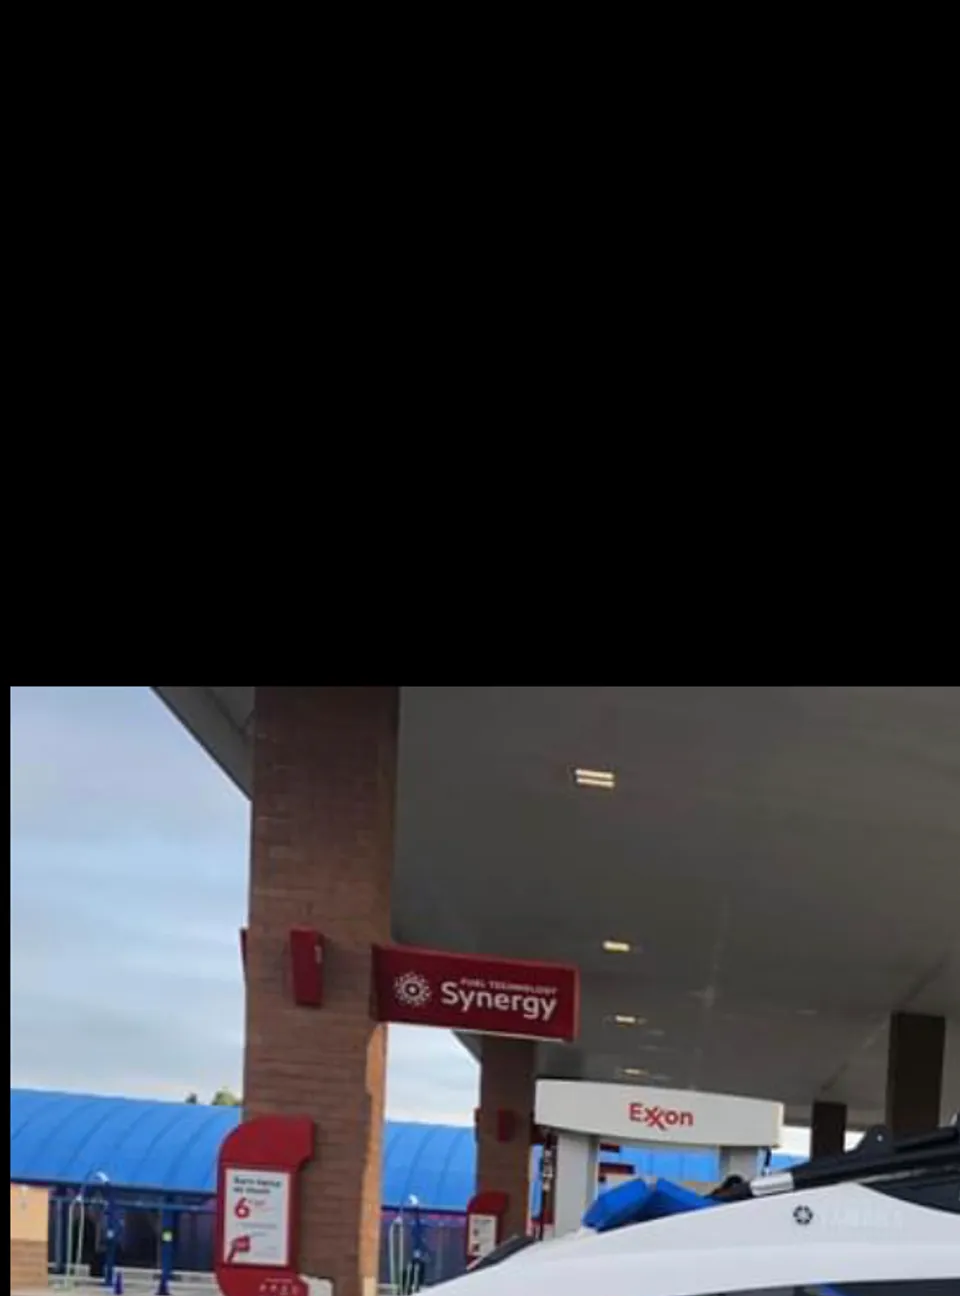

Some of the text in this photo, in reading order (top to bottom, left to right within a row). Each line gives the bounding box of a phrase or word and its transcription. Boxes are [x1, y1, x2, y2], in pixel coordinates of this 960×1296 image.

[440, 981, 557, 1021] Synergy
[629, 1102, 694, 1131] Exxon
[234, 1197, 250, 1219] 6
